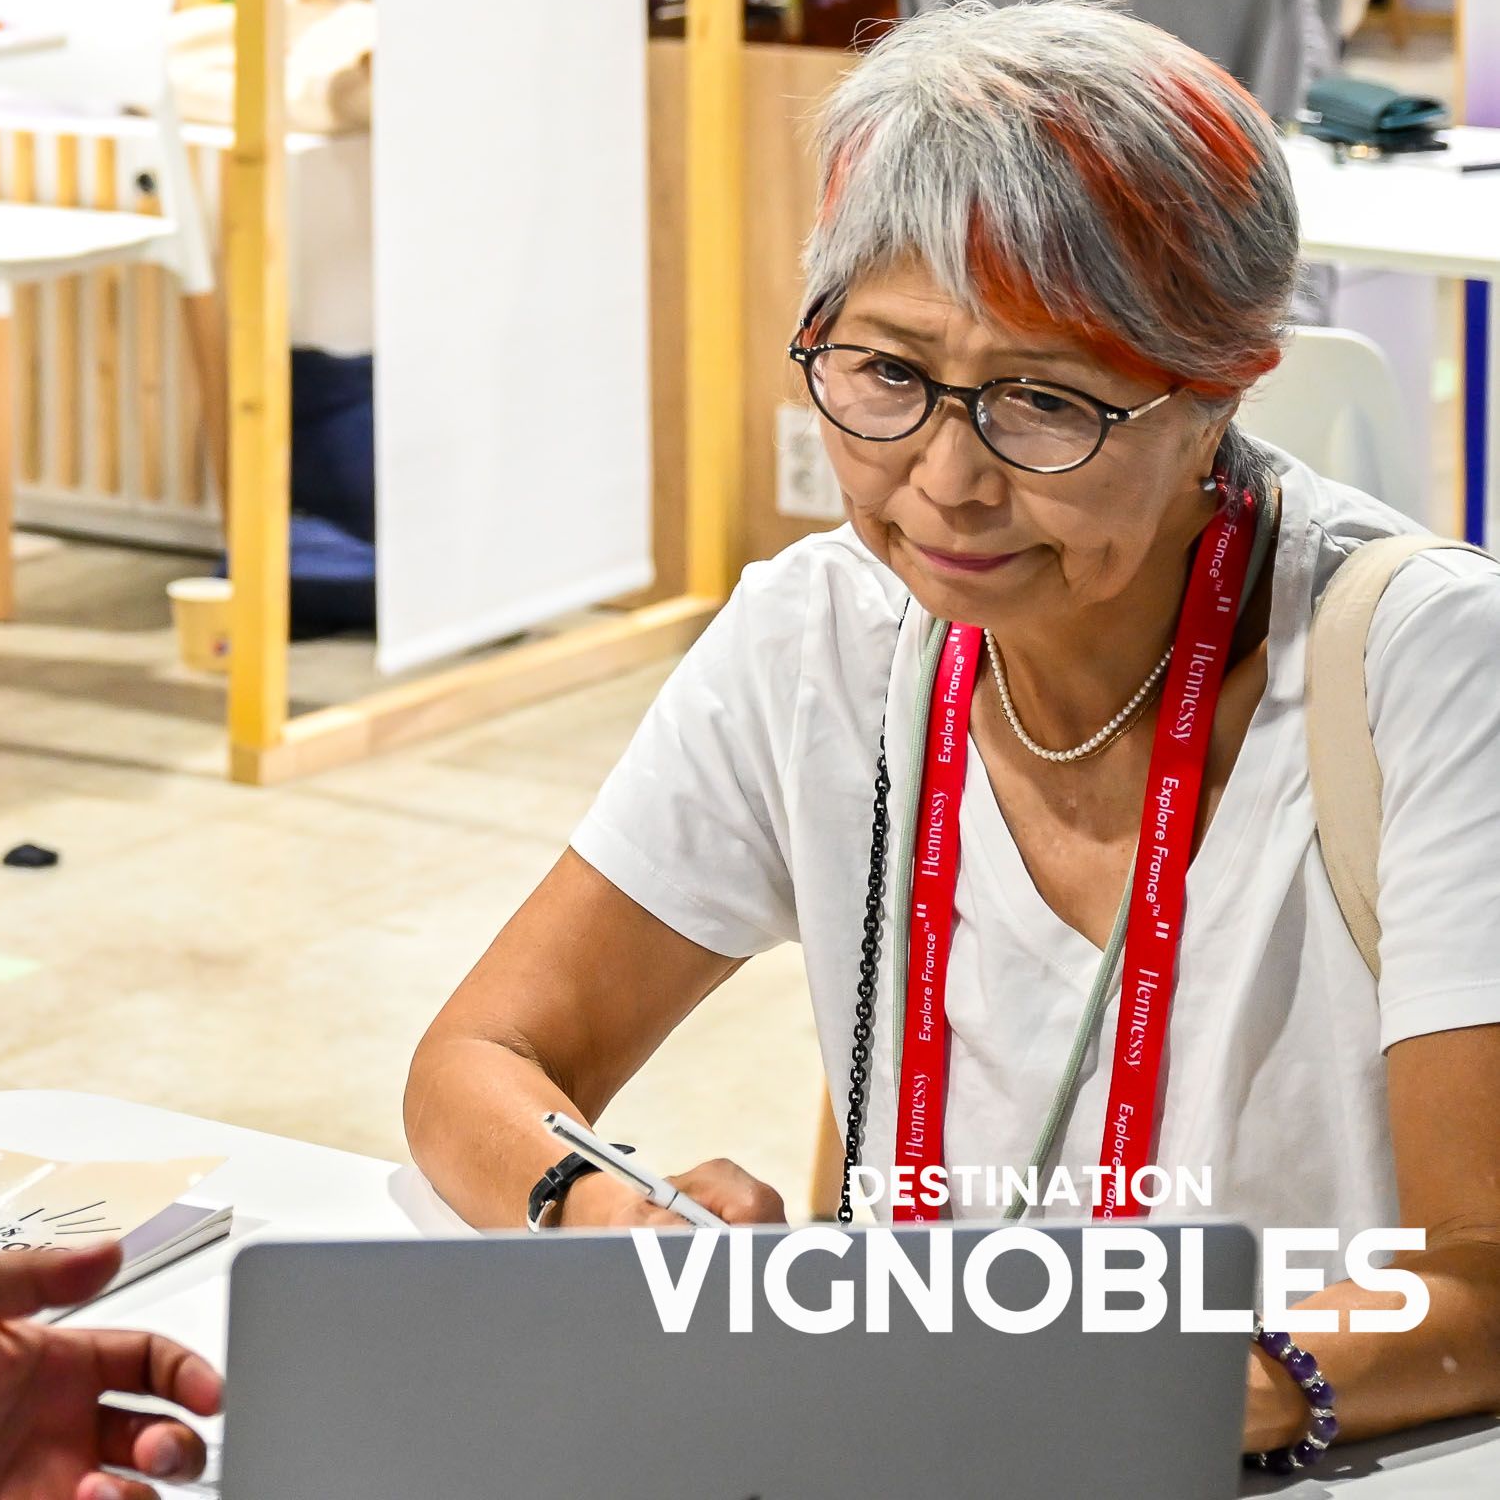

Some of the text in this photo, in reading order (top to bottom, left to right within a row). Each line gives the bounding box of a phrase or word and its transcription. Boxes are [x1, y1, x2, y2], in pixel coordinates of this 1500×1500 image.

[1169, 641, 1217, 747] Hennessy
[938, 706, 956, 764] Explore
[921, 787, 949, 878] Hennessy
[1153, 775, 1179, 841] Explore
[918, 986, 933, 1042] Explore
[1123, 967, 1160, 1075] Hennessy
[905, 1068, 931, 1159] Hennessy
[1112, 1102, 1135, 1167] Explore
